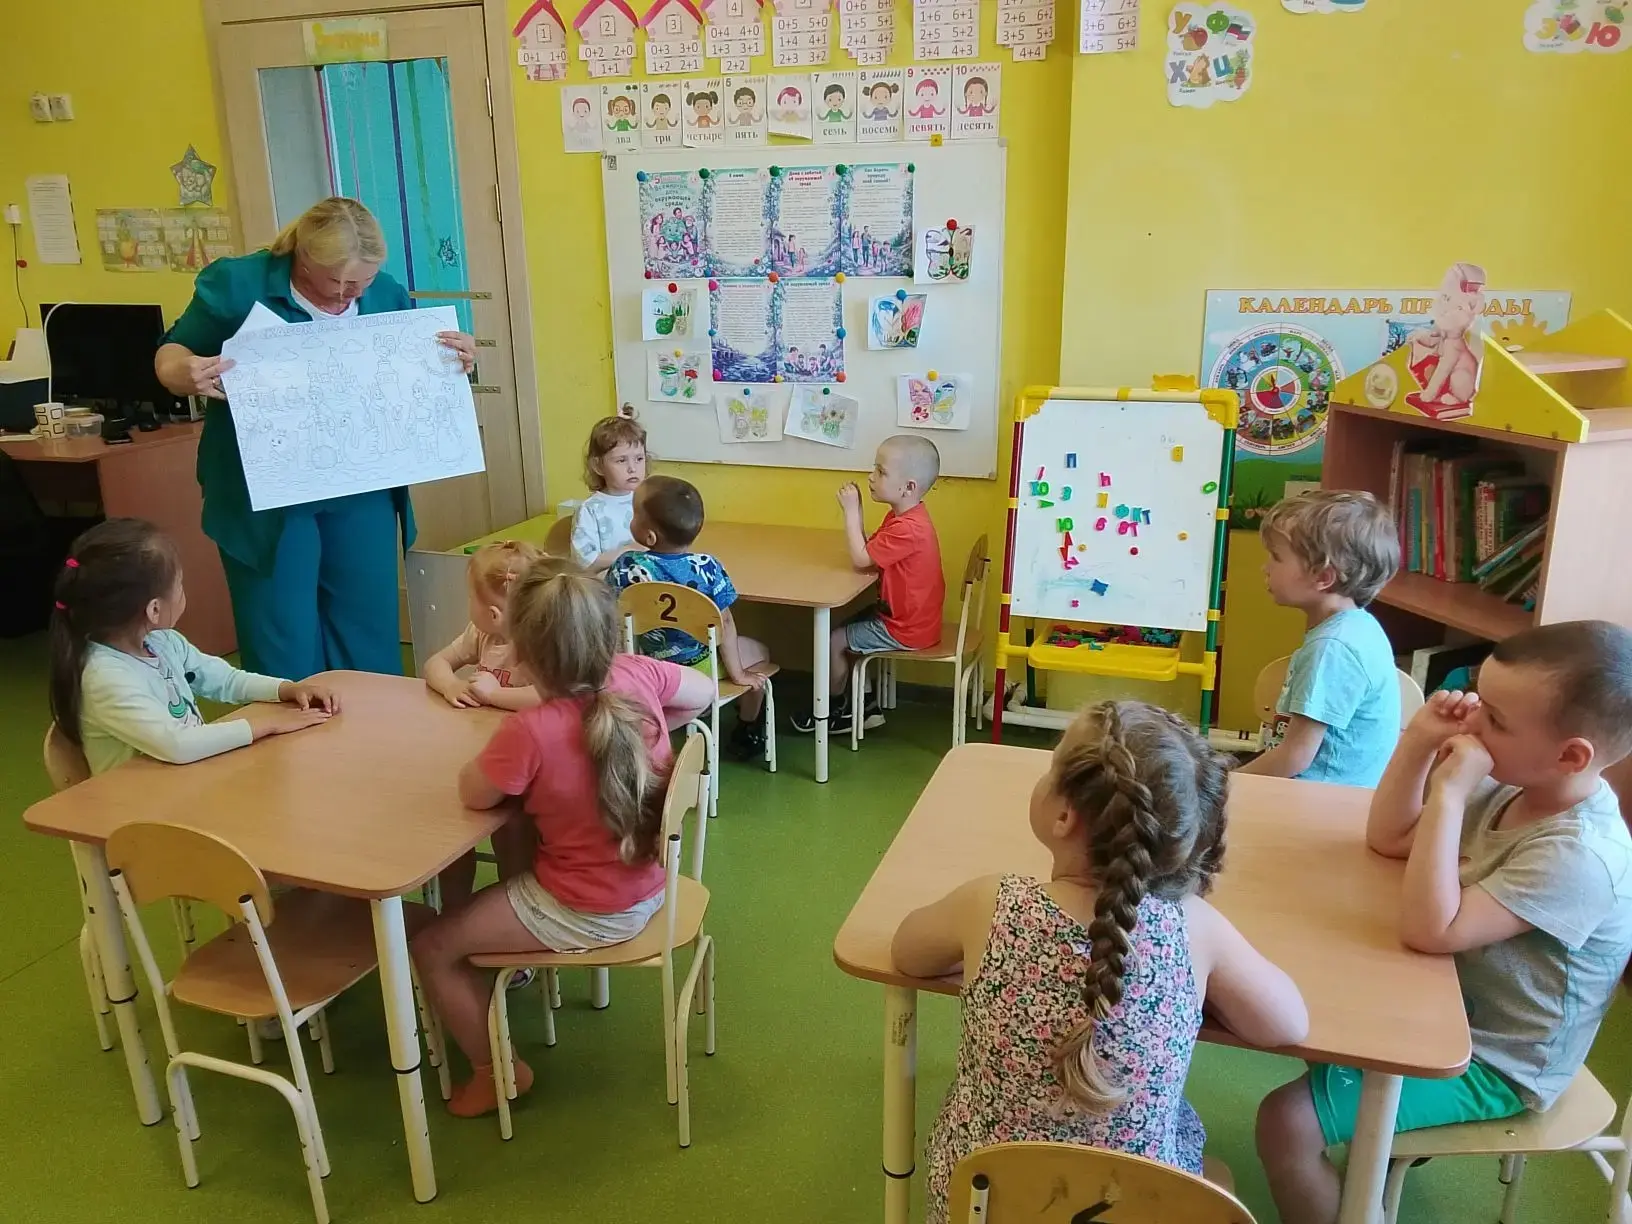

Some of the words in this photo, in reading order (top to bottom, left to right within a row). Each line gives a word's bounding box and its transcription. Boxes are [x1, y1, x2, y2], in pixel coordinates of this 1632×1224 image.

[731, 2, 737, 12] 4
[846, 0, 867, 11] 0+6
[920, 10, 941, 22] 1+6
[952, 8, 973, 20] 6+1
[1004, 12, 1026, 24] 2+6
[603, 21, 611, 32] 2
[671, 20, 677, 30] 3
[778, 19, 798, 30] 0+5
[809, 17, 828, 28] 5+0
[847, 18, 867, 29] 1+5
[877, 15, 893, 27] 5+1
[1084, 19, 1105, 31] 3+6
[1118, 16, 1137, 30] 6+3
[1173, 11, 1192, 34] У
[1206, 10, 1230, 34] Ф
[539, 28, 547, 38] 1
[711, 27, 730, 38] 0+4
[740, 25, 759, 36] 4+0
[920, 29, 941, 40] 2+5
[952, 26, 973, 38] 5+2
[1003, 30, 1025, 41] 3+5
[1585, 22, 1621, 47] Ю
[780, 37, 798, 47] 1+4
[809, 34, 826, 45] 4+1
[847, 35, 867, 46] 2+4
[585, 47, 605, 58] 0+2
[614, 44, 633, 56] 2+0
[651, 45, 670, 55] 0+3
[680, 42, 698, 53] 3+0
[713, 44, 730, 54] 1+3
[741, 42, 759, 53] 3+1
[920, 47, 940, 58] 3+4
[952, 44, 973, 56] 4+3
[1020, 47, 1041, 58] 4+4
[523, 52, 540, 63] 0+1
[550, 51, 566, 61] 1+0
[780, 53, 798, 64] 2+3
[809, 51, 826, 62] 3+2
[862, 52, 882, 63] 3+3
[602, 63, 619, 74] 1+1
[653, 61, 671, 72] 1+2
[680, 59, 699, 70] 2+1
[727, 60, 745, 71] 2+2
[955, 65, 967, 76] 10
[814, 74, 819, 83] 7
[860, 71, 866, 81] 8
[907, 69, 914, 78] 9
[684, 81, 690, 91] 4
[726, 78, 731, 87] 5
[602, 86, 608, 95] 2
[642, 84, 648, 93] 3
[654, 134, 671, 144] три
[1238, 297, 1394, 315] КАЛЕНДАРЬ
[1399, 297, 1533, 317] ПРДЫ
[658, 593, 679, 622] 2
